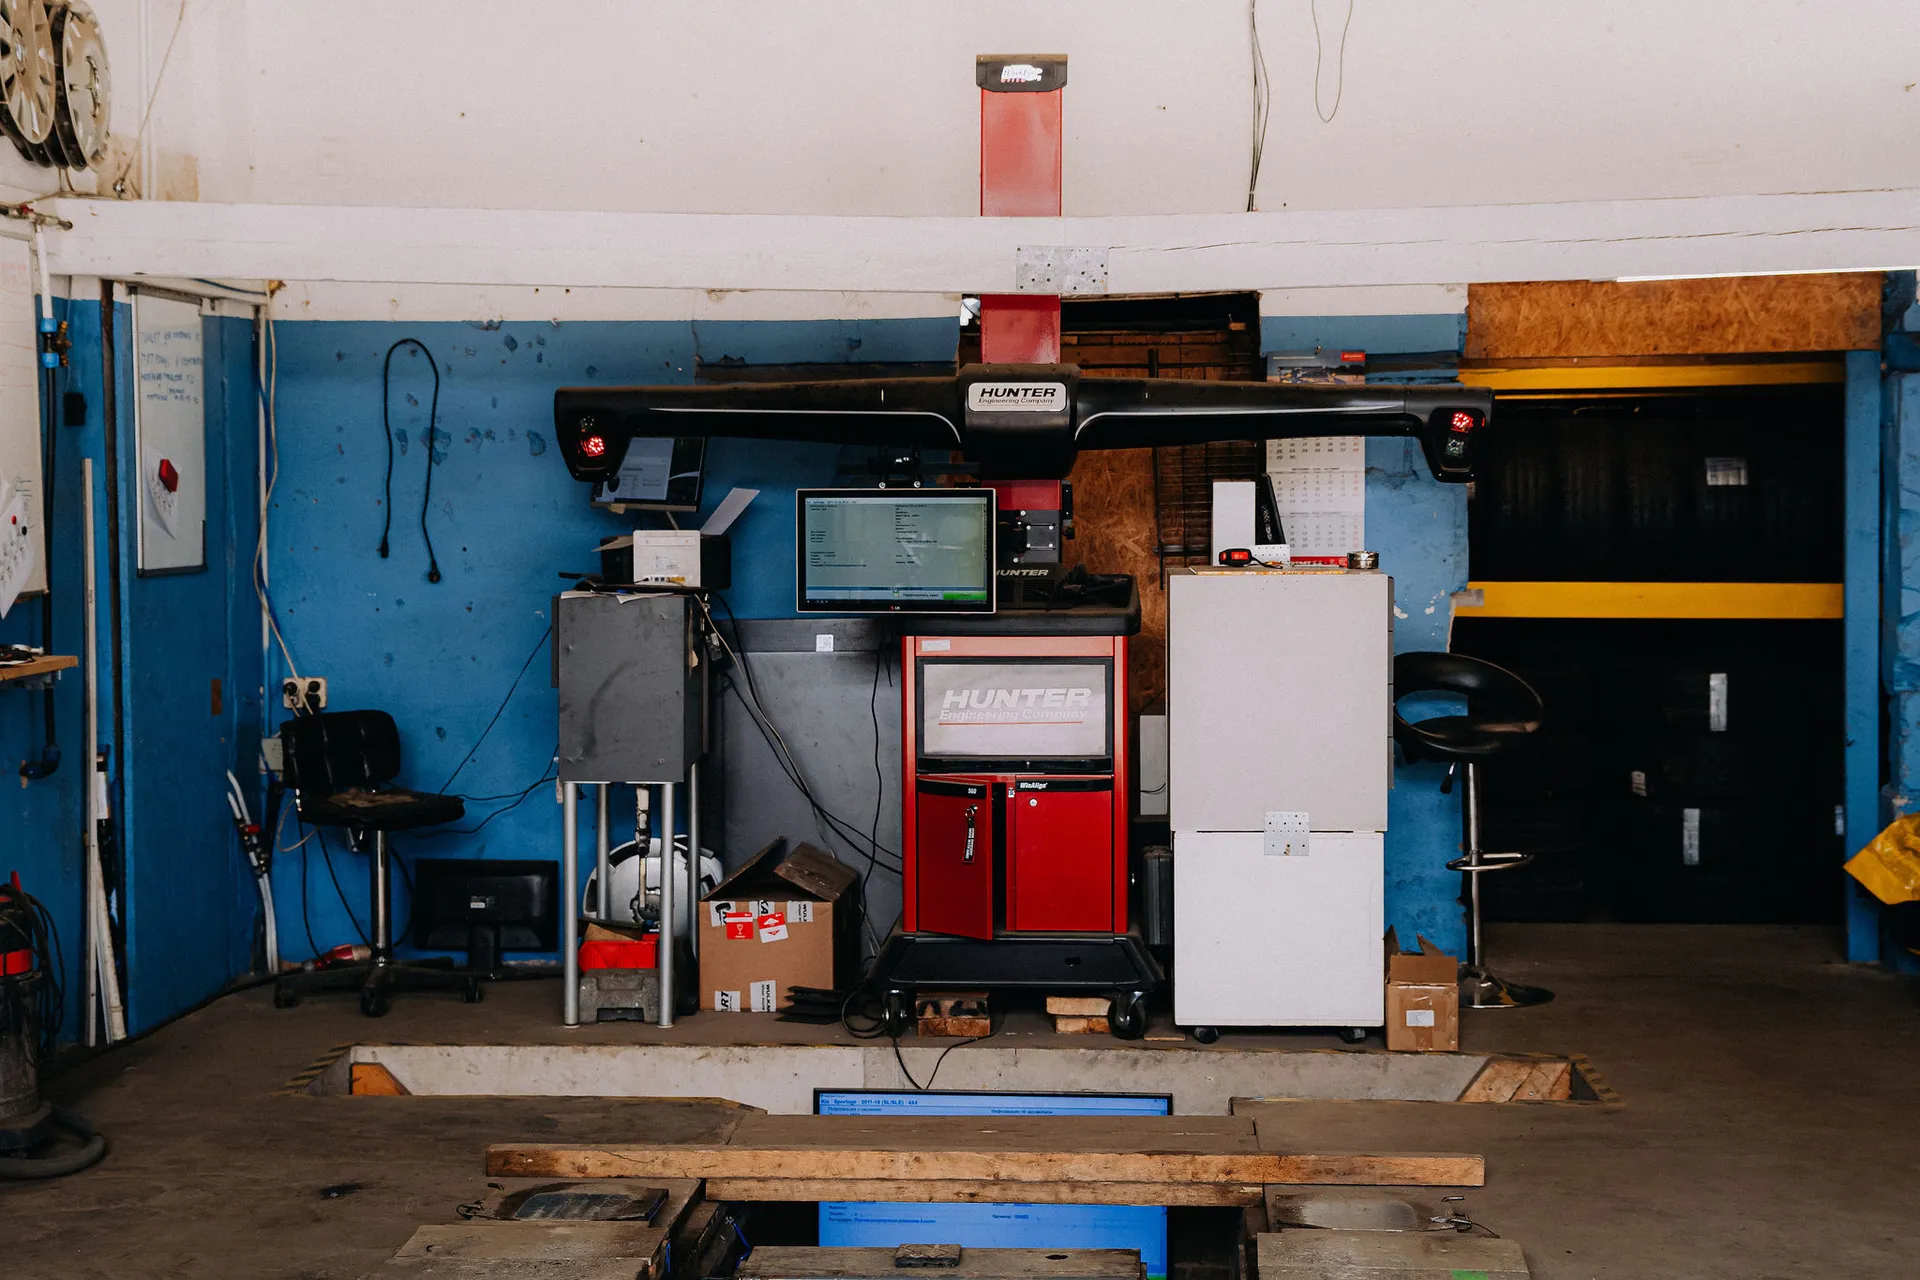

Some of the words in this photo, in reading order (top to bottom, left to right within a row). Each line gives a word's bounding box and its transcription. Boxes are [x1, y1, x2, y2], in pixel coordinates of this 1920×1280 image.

[980, 387, 1057, 398] HUNTER
[941, 688, 1092, 709] HUNTER
[939, 709, 1020, 721] Engineering
